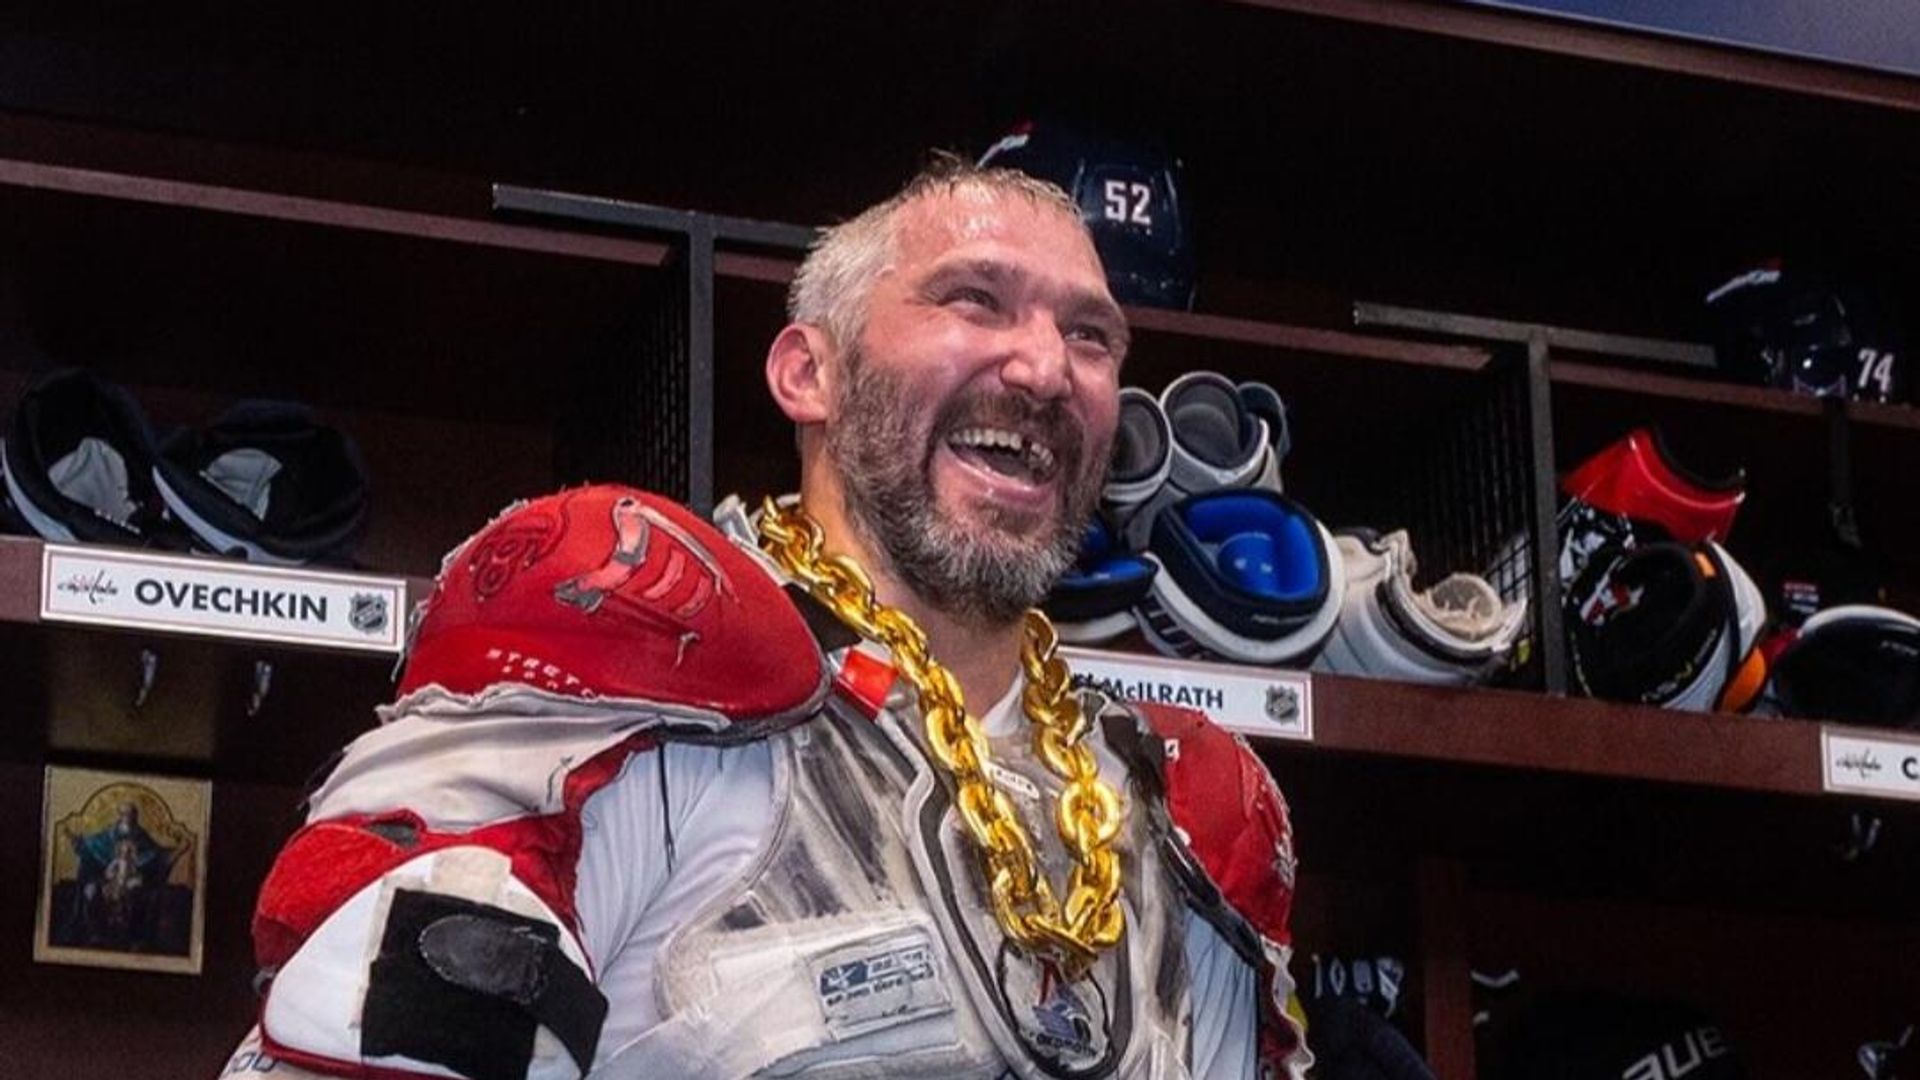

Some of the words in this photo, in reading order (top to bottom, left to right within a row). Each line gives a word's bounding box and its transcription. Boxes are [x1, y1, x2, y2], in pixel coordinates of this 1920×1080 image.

[1104, 179, 1152, 226] 52
[1857, 348, 1896, 393] 74
[134, 578, 328, 623] OVECHKIN
